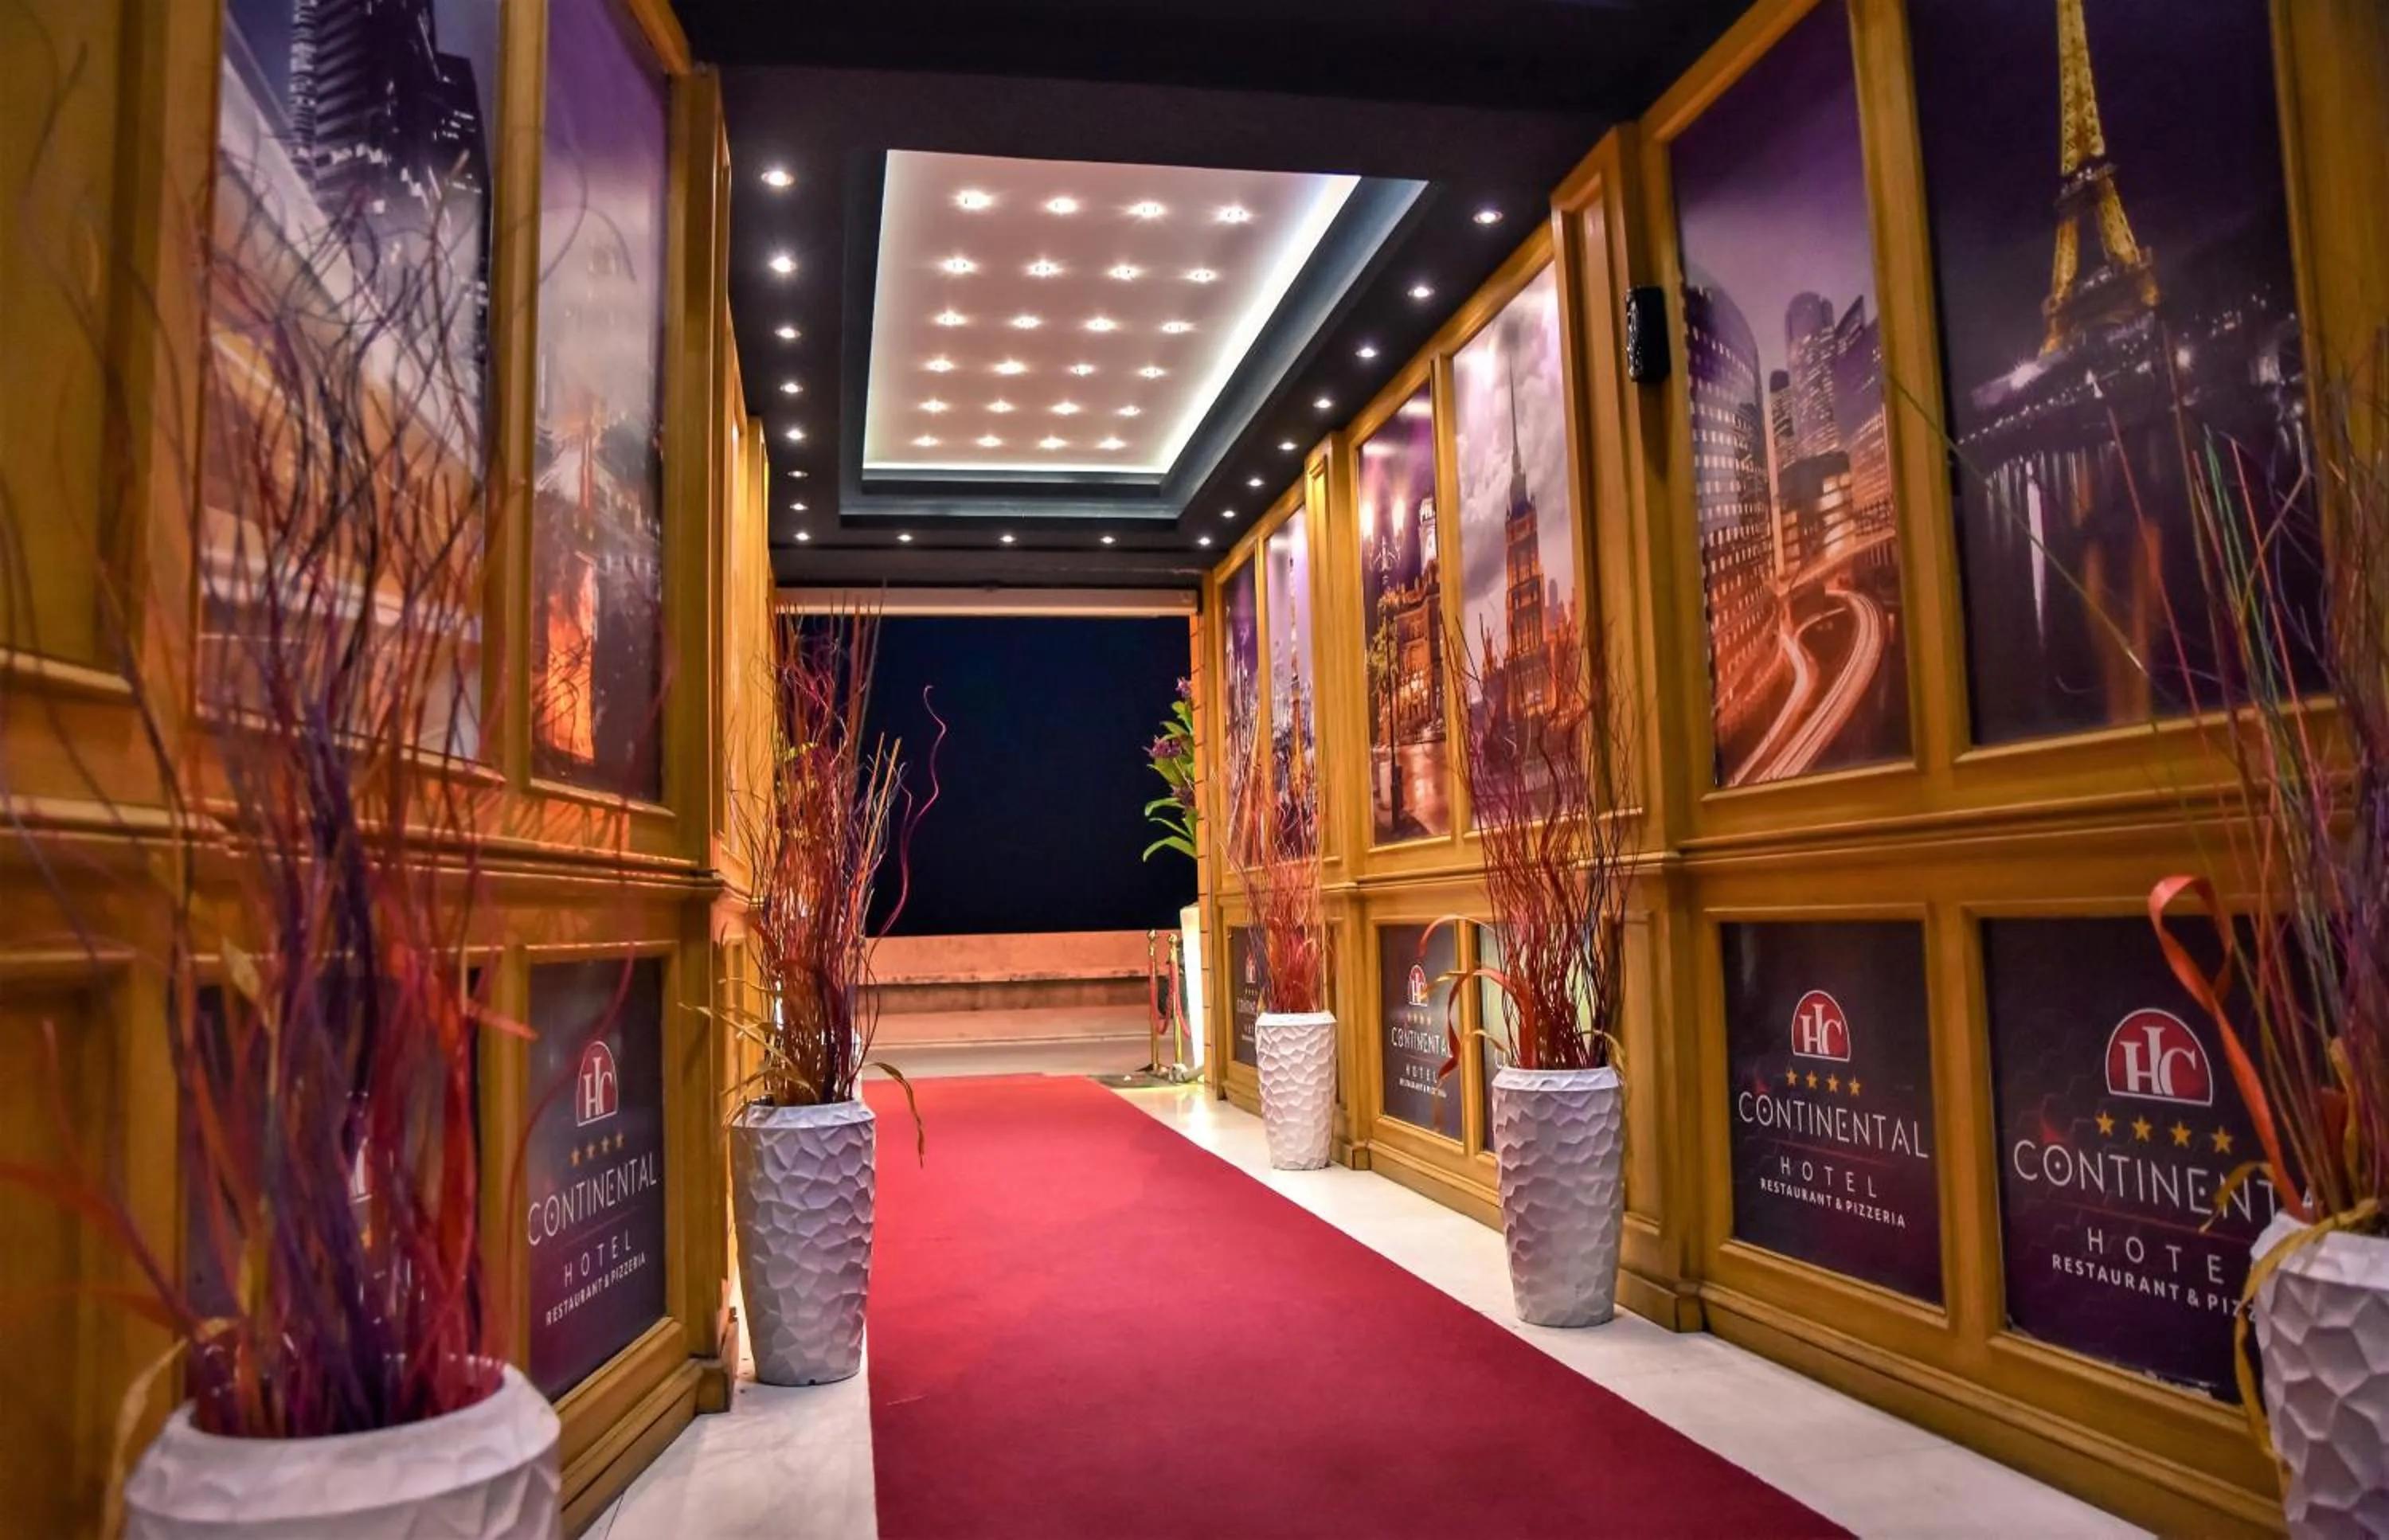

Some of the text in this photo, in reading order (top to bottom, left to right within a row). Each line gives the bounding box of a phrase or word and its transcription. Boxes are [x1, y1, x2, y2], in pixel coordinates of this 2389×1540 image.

[1738, 1091, 1929, 1158] CONTINENTAL
[528, 1152, 657, 1246] CONTINENTAL
[1759, 1178, 1906, 1228] RESTAURANT & PIZZERIA
[1780, 1157, 1877, 1198] HOTEL
[2014, 1139, 2313, 1223] CONTINENT
[563, 1229, 631, 1289] HOTEL
[2052, 1253, 2180, 1301] RESTAURANT
[2188, 1288, 2199, 1307] &
[2087, 1228, 2225, 1285] HOTE
[545, 1279, 603, 1327] RESTAURANT
[610, 1251, 647, 1283] PIZZERIA
